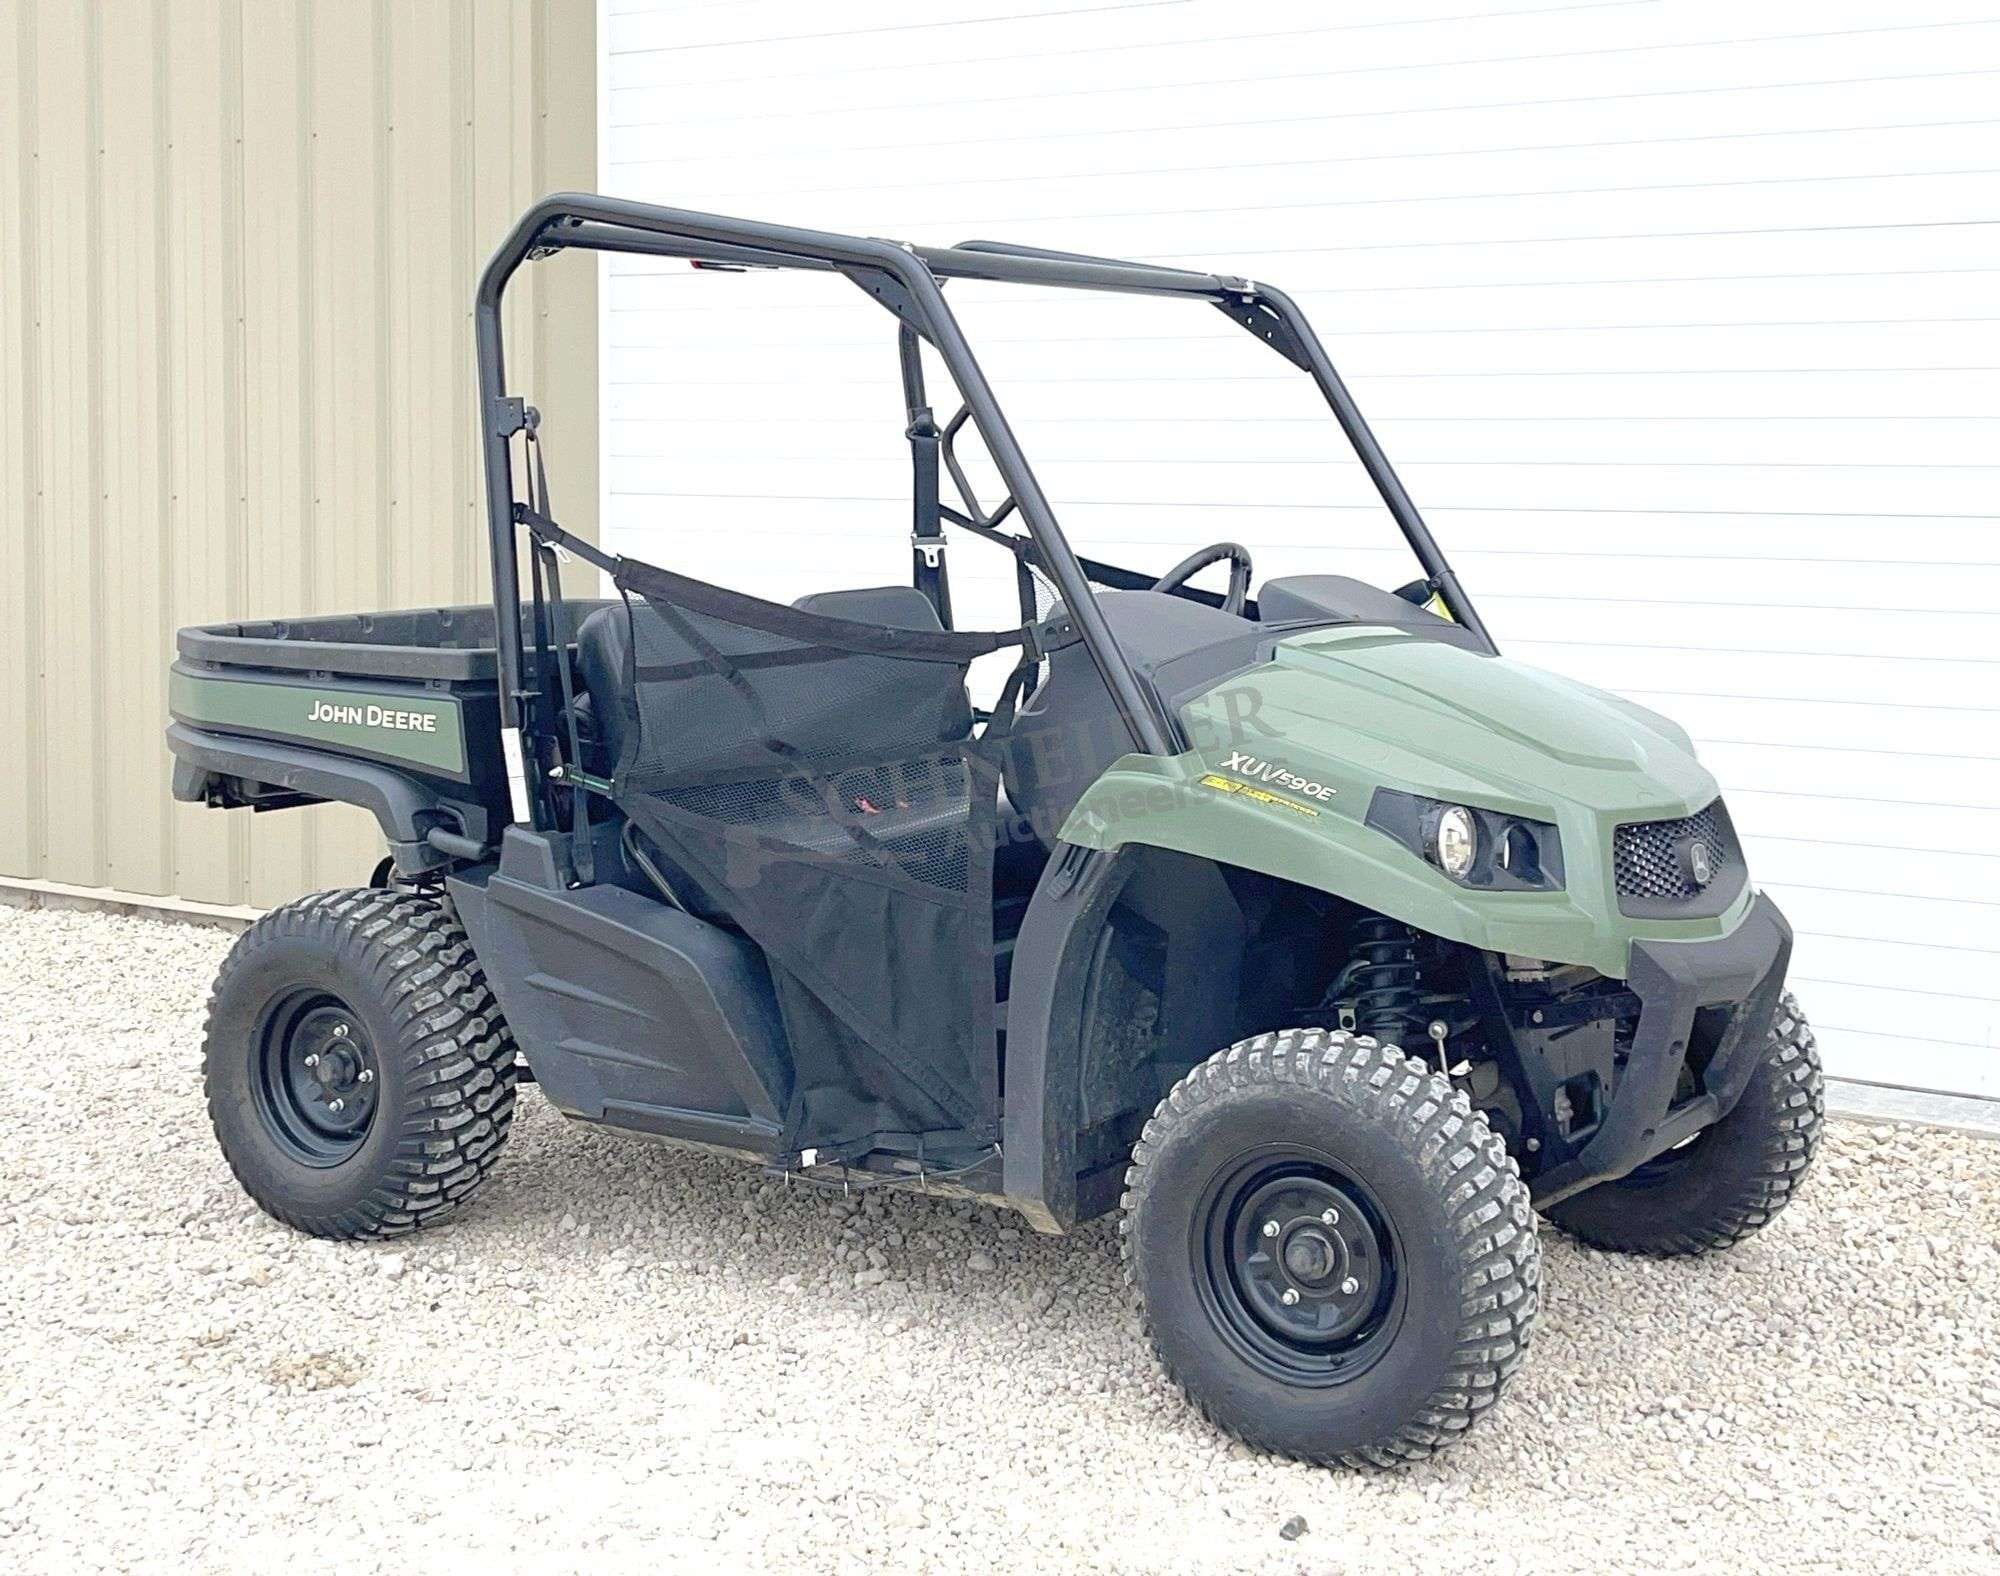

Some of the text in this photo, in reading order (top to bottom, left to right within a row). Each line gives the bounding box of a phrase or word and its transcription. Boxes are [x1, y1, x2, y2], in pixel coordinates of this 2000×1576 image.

[308, 700, 437, 732] JOHN DEERE
[1219, 750, 1338, 802] XUV590E
